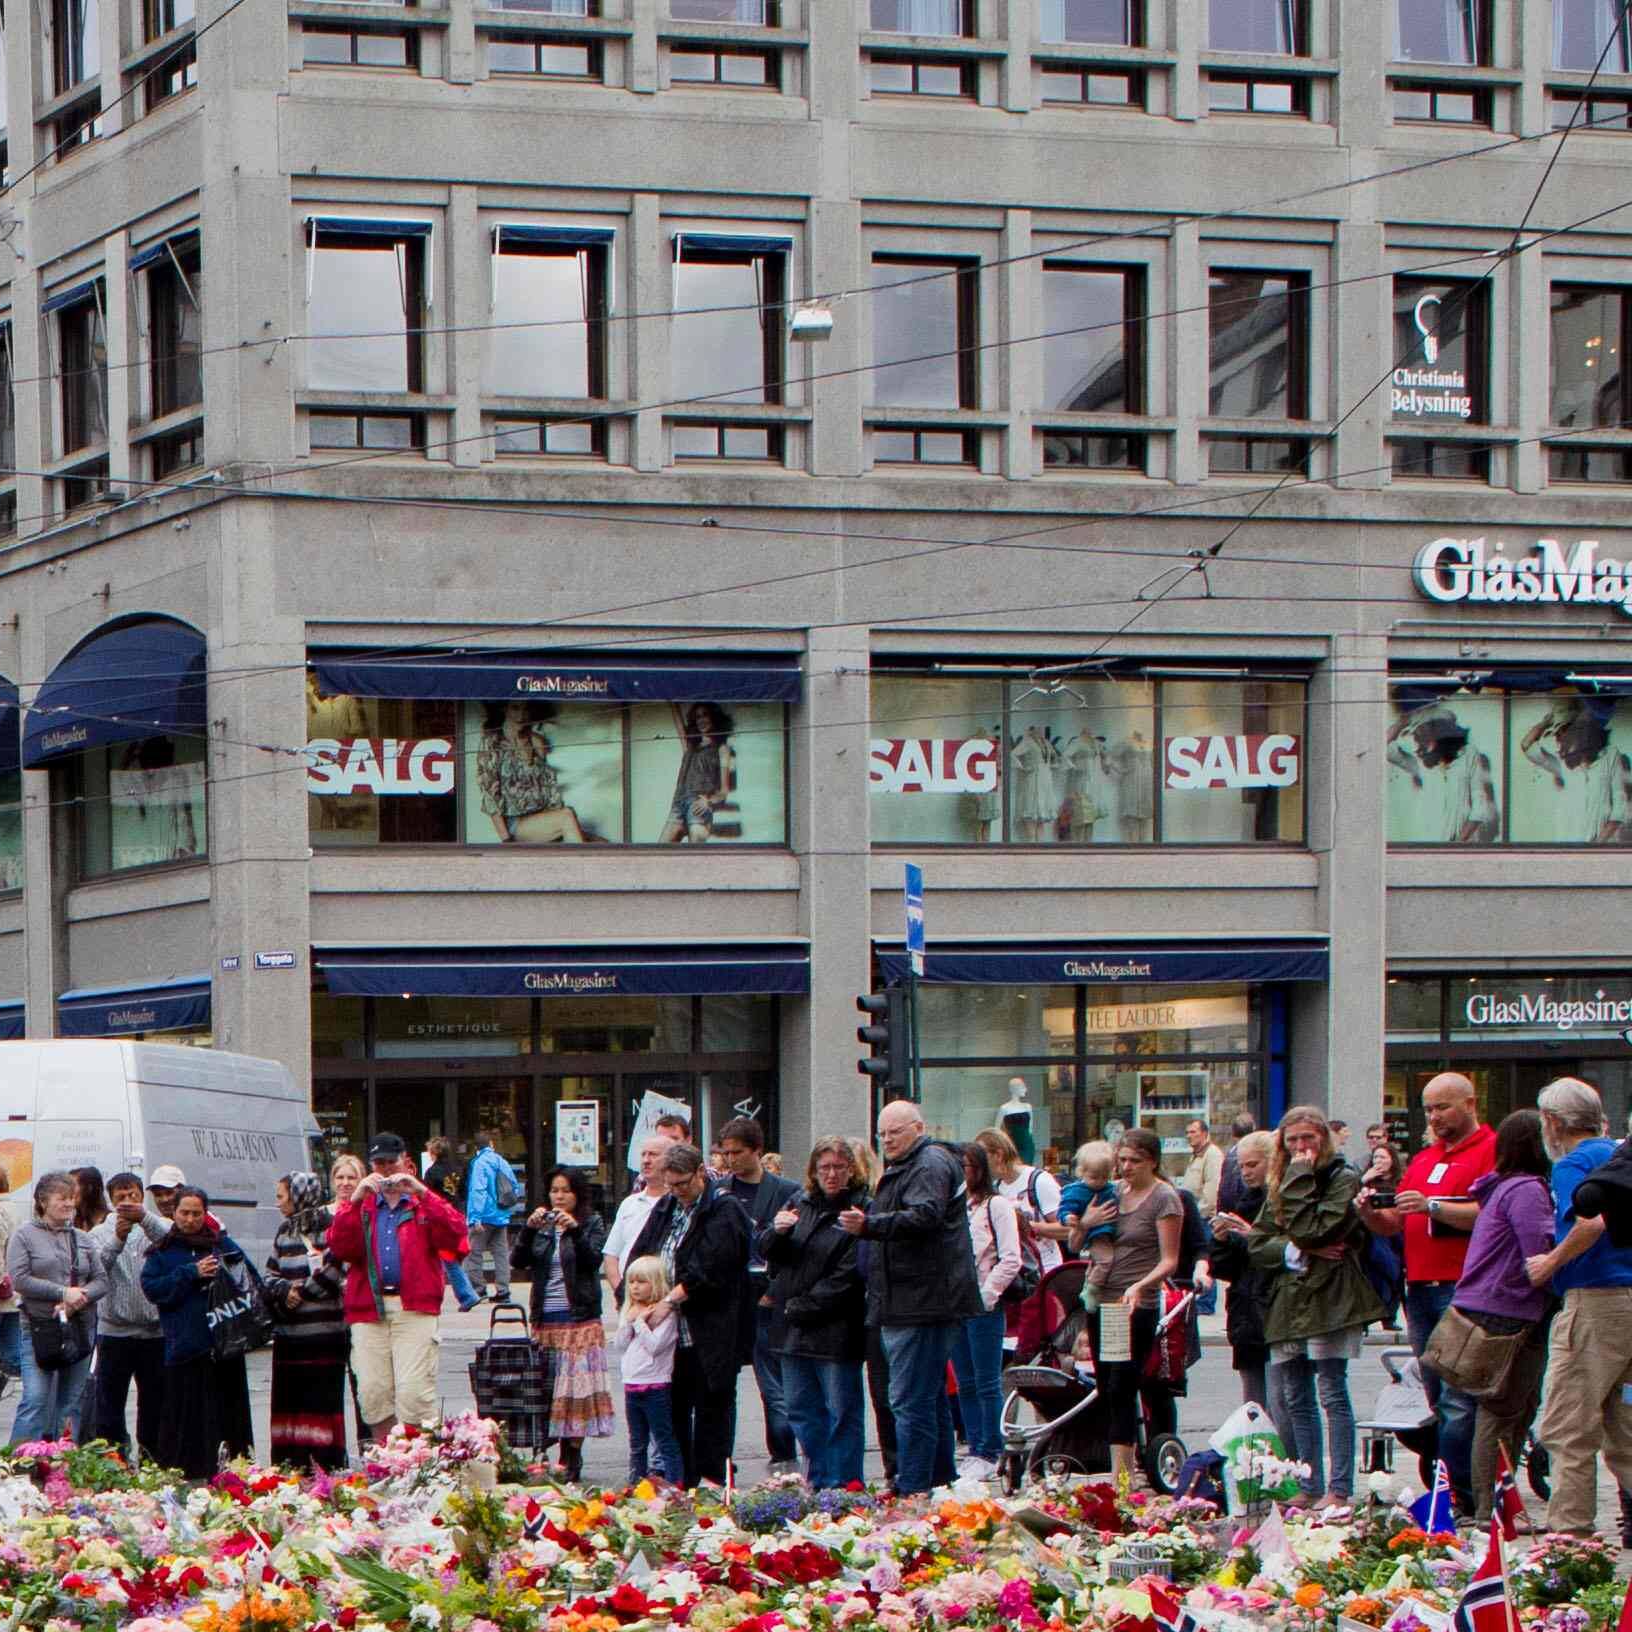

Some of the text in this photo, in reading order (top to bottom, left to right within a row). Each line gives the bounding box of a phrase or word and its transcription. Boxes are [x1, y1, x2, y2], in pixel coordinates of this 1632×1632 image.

[1393, 368, 1465, 388] Christiania
[1391, 389, 1472, 418] Belysning
[307, 738, 455, 796] SALG
[869, 737, 997, 794] SALG
[1167, 734, 1298, 790] SALG
[524, 971, 617, 992] GlasMagasinet
[1063, 959, 1152, 979] GlasMagasinet
[408, 1023, 500, 1034] ESTHETIQUE
[1118, 1007, 1176, 1027] LAUDER
[225, 1132, 278, 1162] SAMSON
